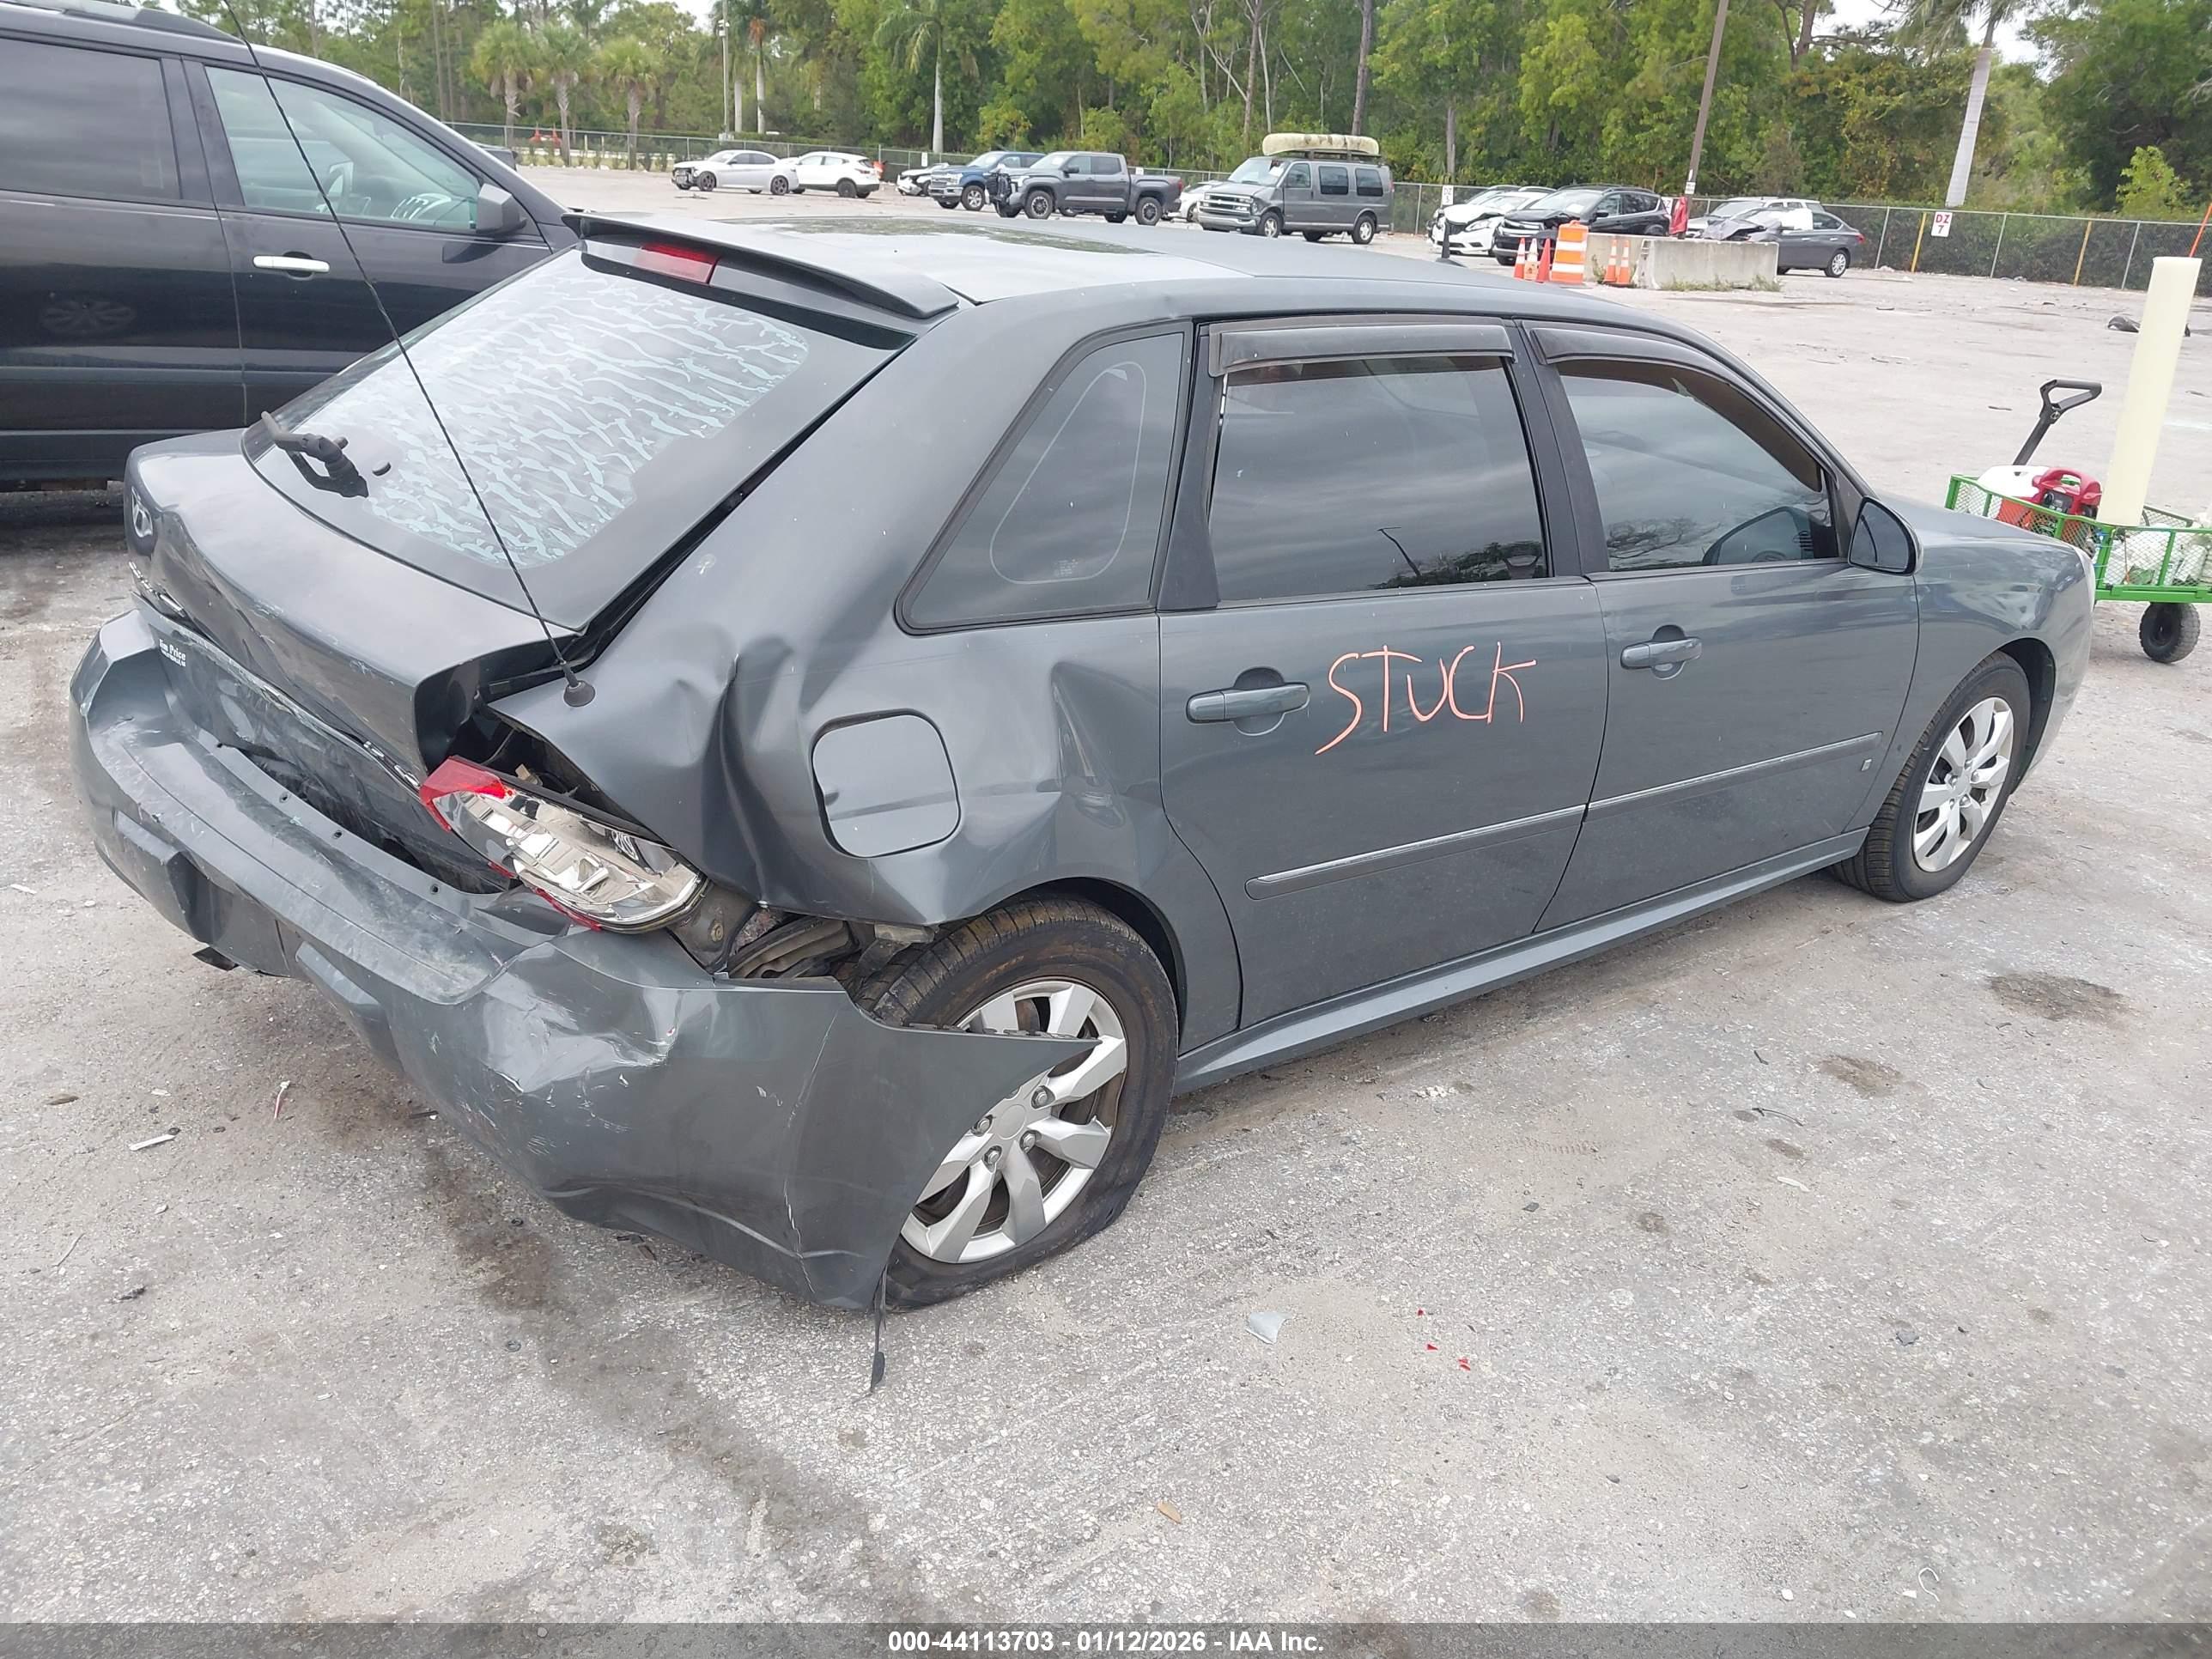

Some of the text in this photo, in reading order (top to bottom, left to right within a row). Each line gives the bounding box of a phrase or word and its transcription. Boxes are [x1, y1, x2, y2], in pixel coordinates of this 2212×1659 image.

[1936, 214, 1950, 223] DZ
[1937, 224, 1945, 234] 7
[169, 644, 186, 661] Price
[1315, 641, 1537, 755] STUCK
